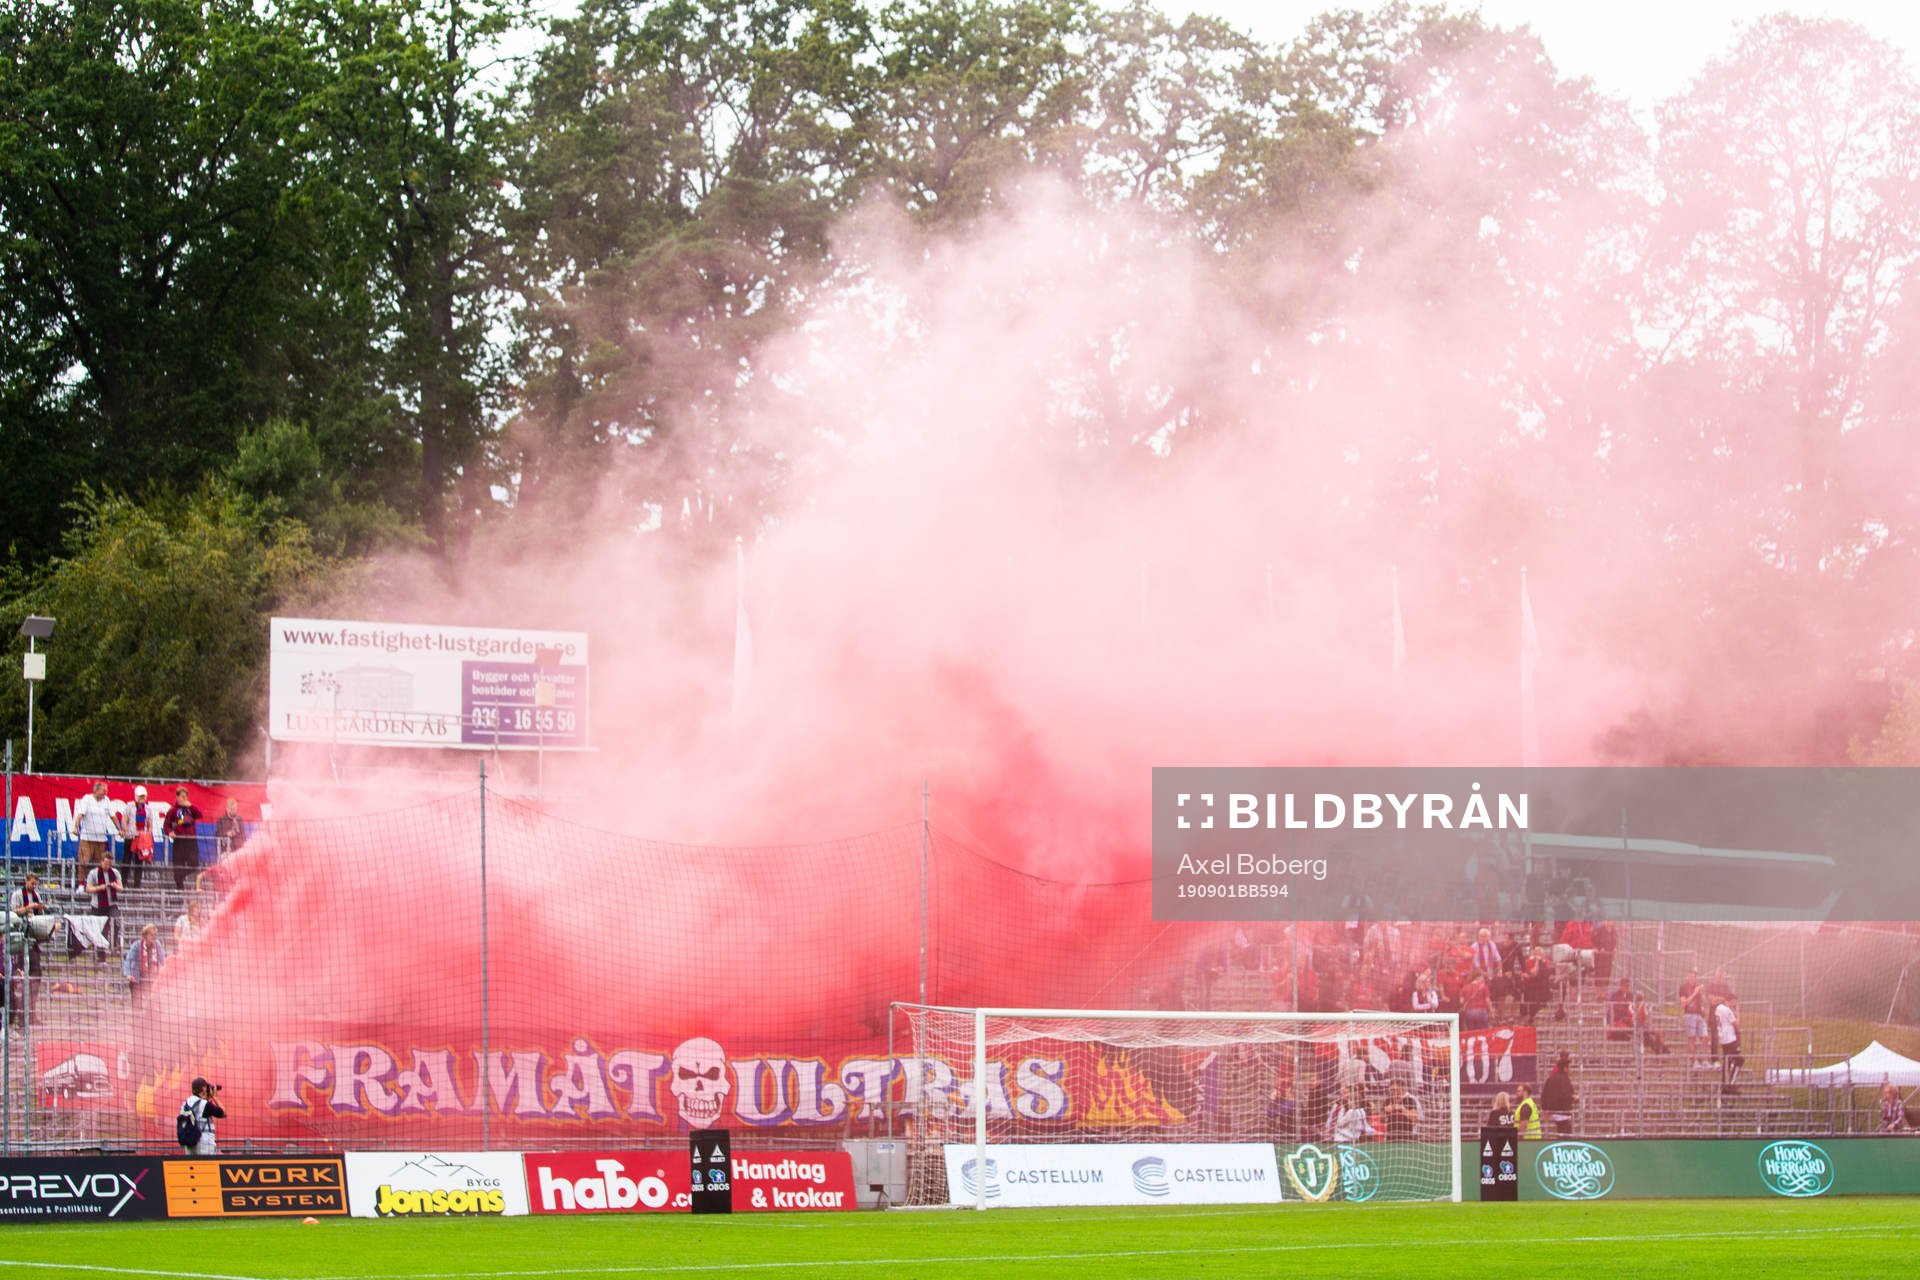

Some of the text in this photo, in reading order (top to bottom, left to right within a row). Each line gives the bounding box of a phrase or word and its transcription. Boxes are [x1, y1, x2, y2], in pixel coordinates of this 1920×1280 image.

[283, 629, 577, 657] www.fastighet-lustgardense
[514, 709, 531, 730] 16
[557, 711, 576, 731] 50
[268, 1037, 670, 1121] FRAMÅT
[730, 1055, 1068, 1124] ULTRAS
[225, 1168, 335, 1184] WORK
[731, 1158, 826, 1184] Handtag
[1005, 1169, 1104, 1184] CASTELLUM
[1174, 1168, 1266, 1182] CASTELLUM
[466, 1178, 501, 1188] BYGG
[231, 1195, 335, 1206] SYSTEM
[375, 1185, 505, 1216] Jonsons
[751, 1187, 845, 1208] & krokar
